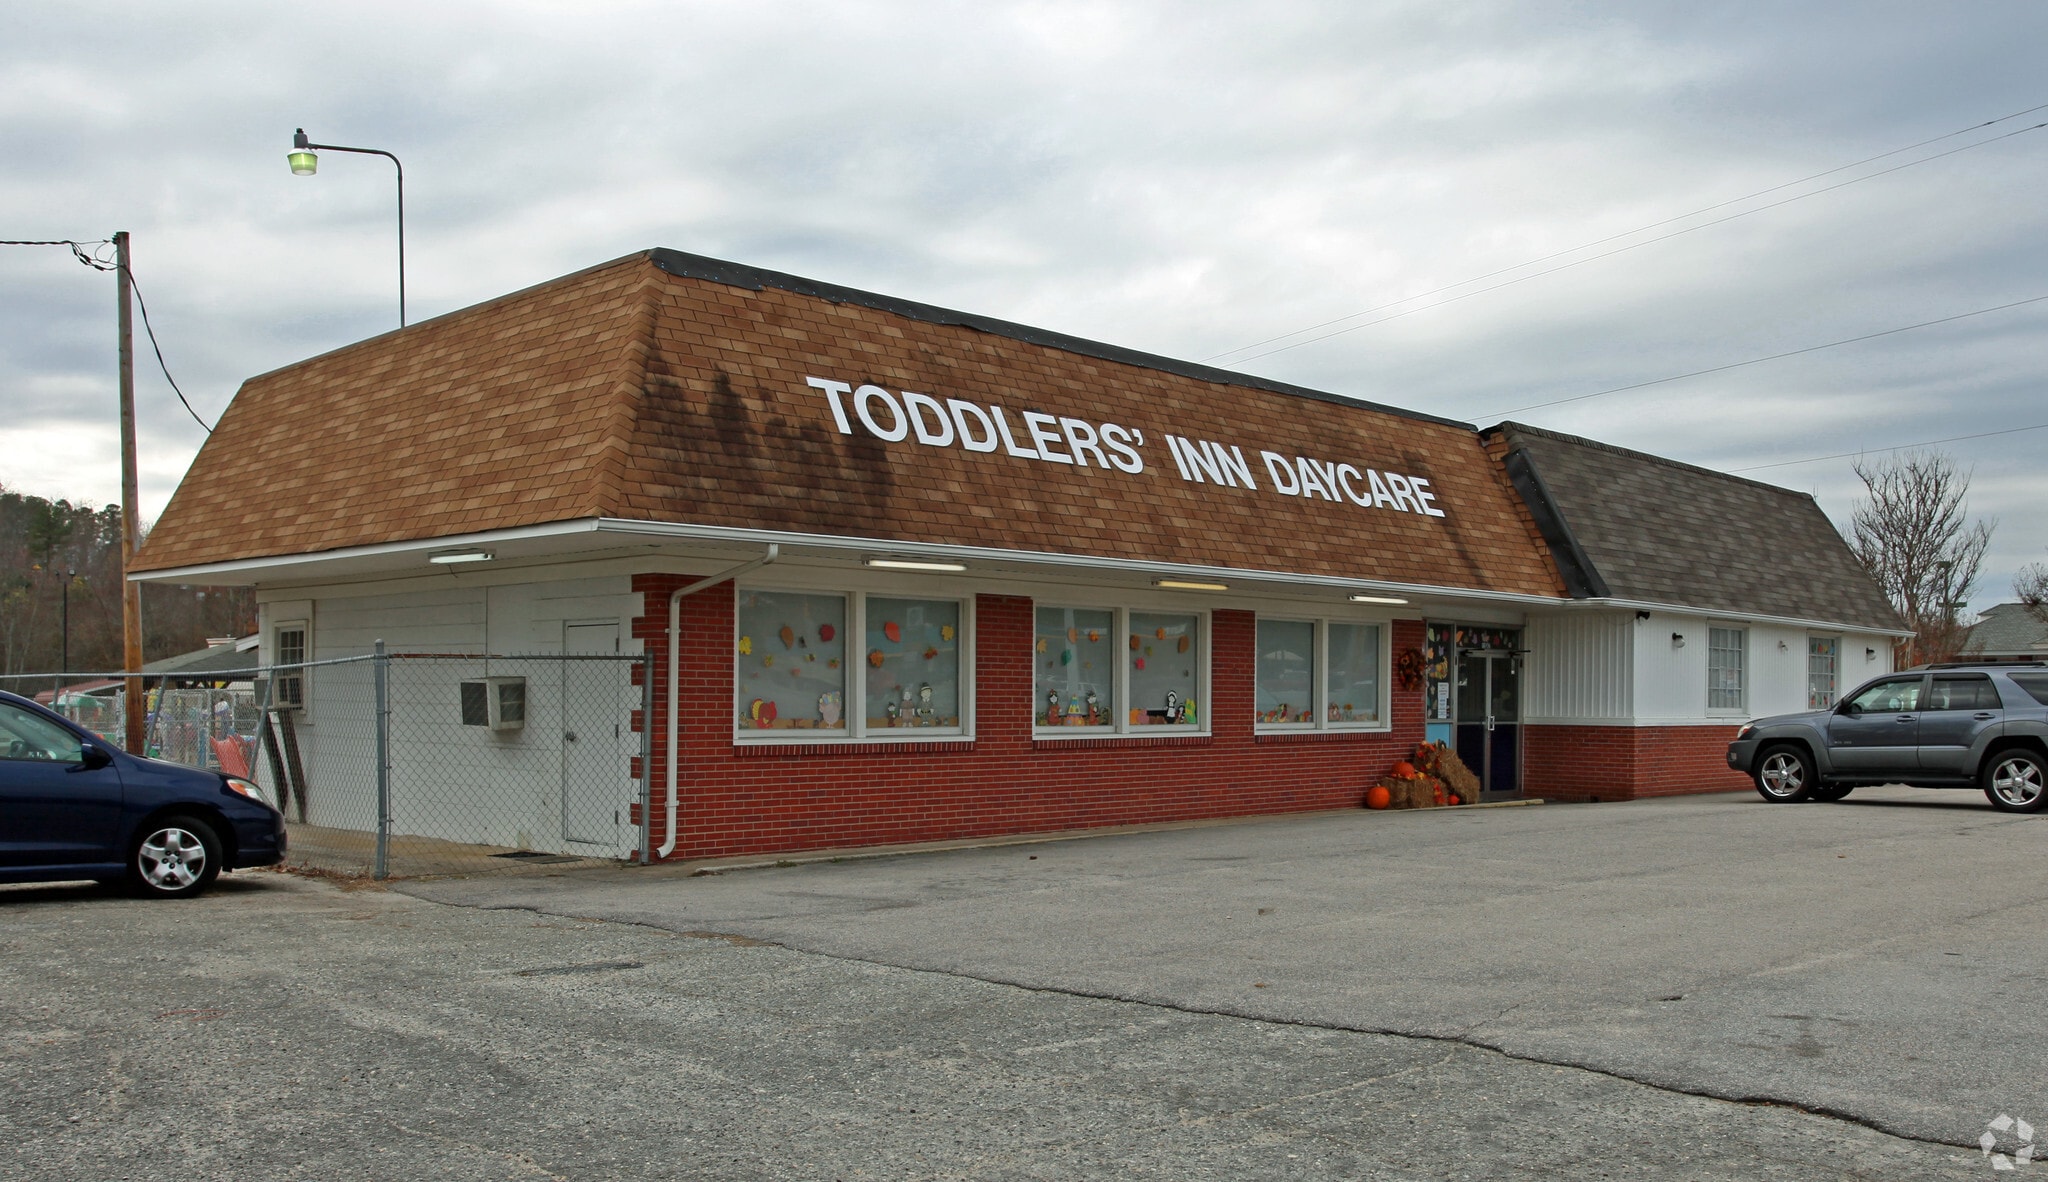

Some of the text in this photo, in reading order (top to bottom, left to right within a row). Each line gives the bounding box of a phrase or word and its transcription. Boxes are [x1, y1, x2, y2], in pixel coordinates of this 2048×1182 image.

[805, 376, 1446, 518] TODDLERS' INN DAYCARE
